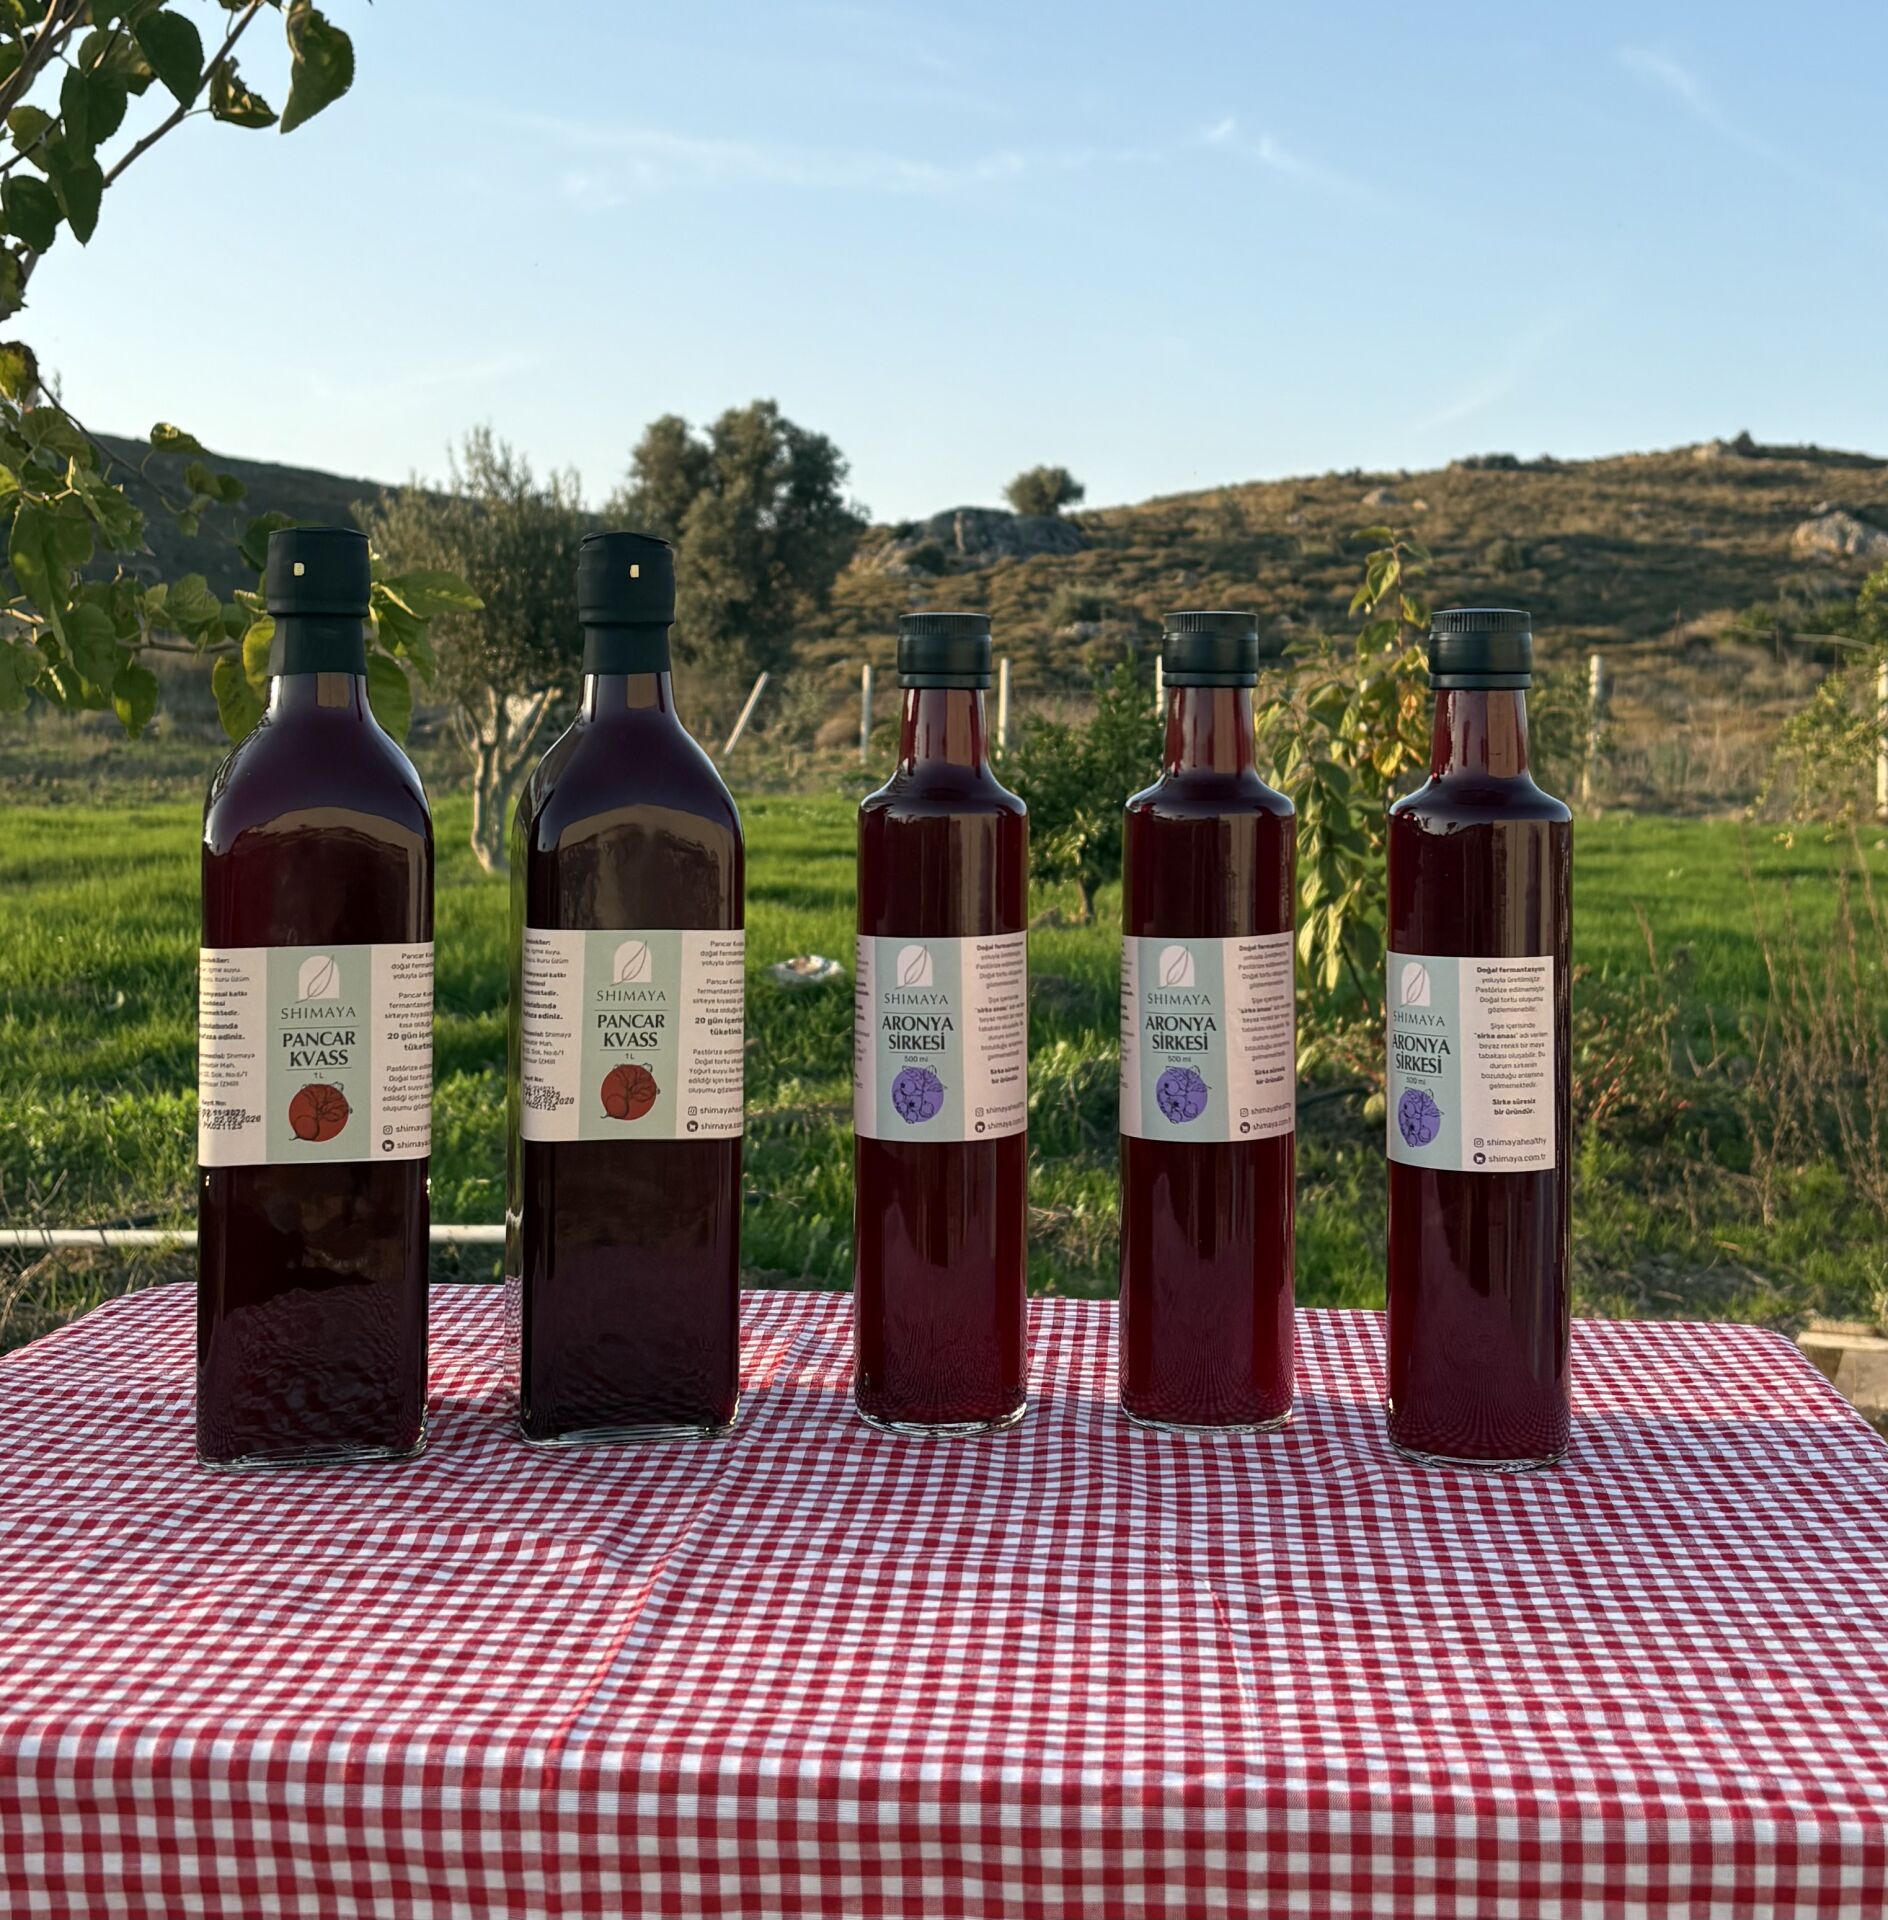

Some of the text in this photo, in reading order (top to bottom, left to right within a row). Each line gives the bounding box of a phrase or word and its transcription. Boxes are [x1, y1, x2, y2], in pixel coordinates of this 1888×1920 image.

[596, 990, 666, 1001] SHIMAYA
[884, 993, 948, 1005] SHIMAYA
[1147, 993, 1211, 1006] SHIMAYA
[281, 1006, 356, 1020] SHIMAYA
[1393, 1010, 1446, 1027] SHIMAYA
[598, 1014, 664, 1028] PANCAR
[708, 1017, 723, 1025] gün
[882, 1016, 954, 1031] ARONYA
[1146, 1016, 1216, 1032] ARONYA
[283, 1031, 356, 1047] PANCAR
[401, 1032, 418, 1040] gün
[604, 1032, 658, 1047] KVASS
[888, 1032, 945, 1050] SİRKESİ
[1152, 1032, 1208, 1050] SİRKESİ
[1392, 1034, 1451, 1054] ARONYA
[290, 1049, 348, 1066] KVASS
[1396, 1051, 1442, 1074] SİRKESİ
[1487, 1138, 1546, 1147] shimayahealthy
[1488, 1153, 1546, 1164] shimaya.com.tr
